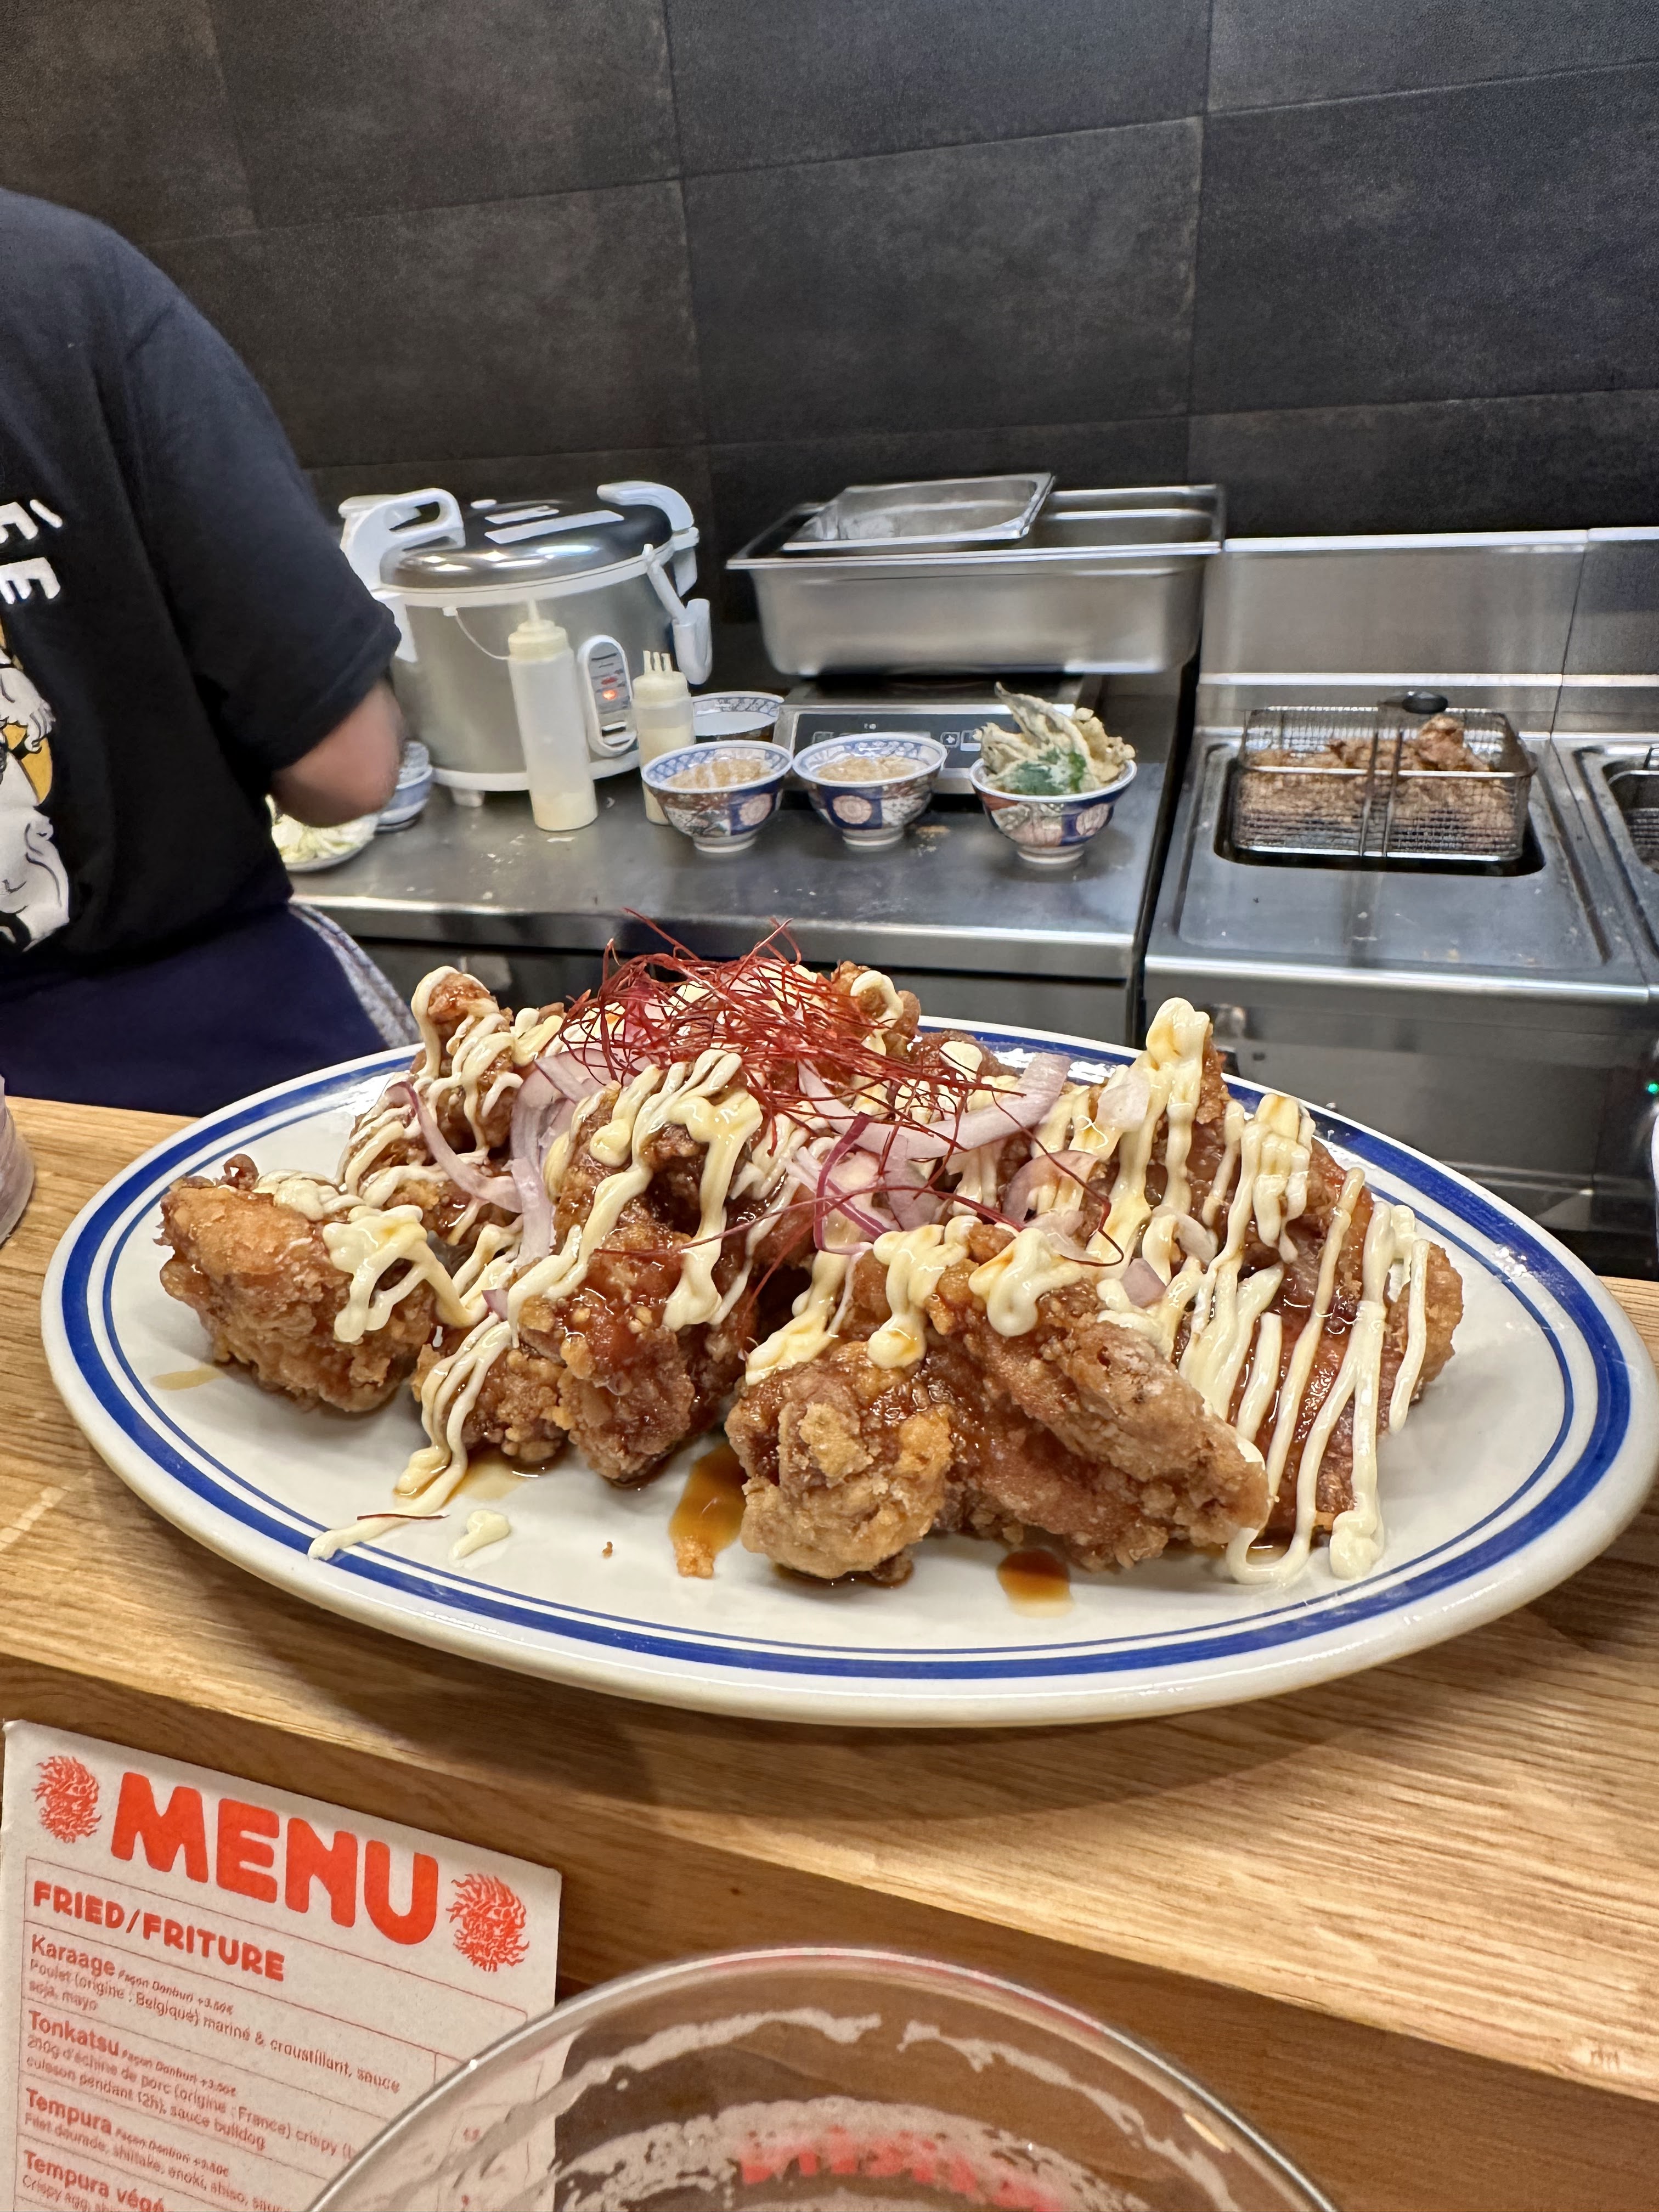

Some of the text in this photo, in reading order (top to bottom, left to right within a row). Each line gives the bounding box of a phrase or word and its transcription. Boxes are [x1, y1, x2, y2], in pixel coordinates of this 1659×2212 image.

[111, 1771, 438, 1945] MENU
[32, 1934, 115, 1977] Karaage
[33, 1881, 285, 1982] FRIED/FRITURE
[62, 1991, 98, 2011] mayo
[29, 2010, 119, 2056] Tonkatsu
[26, 2087, 112, 2135] Tempura
[24, 2149, 109, 2198] Tempura
